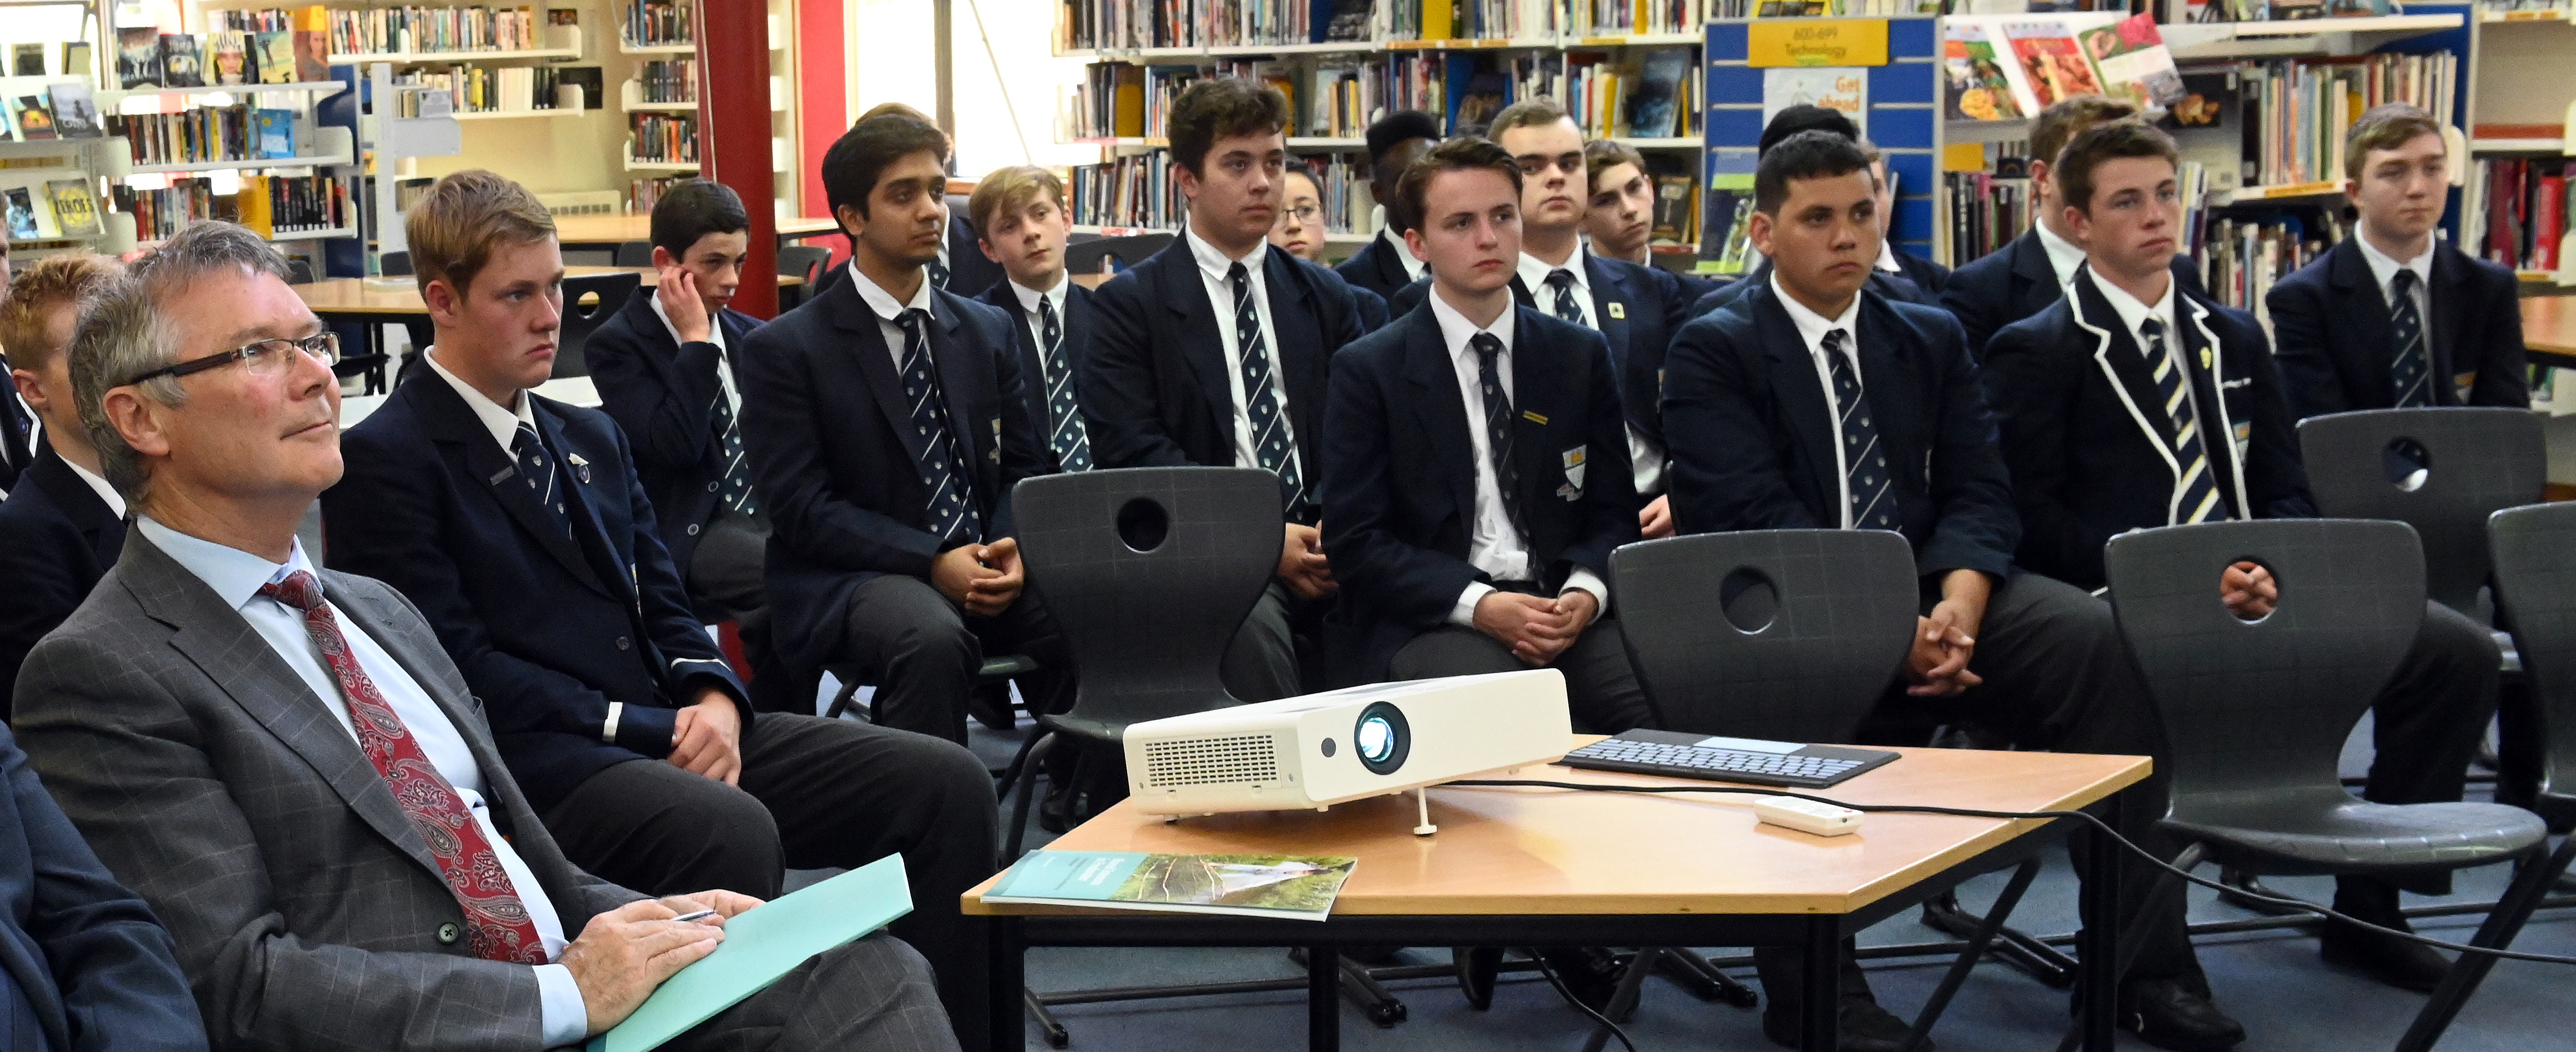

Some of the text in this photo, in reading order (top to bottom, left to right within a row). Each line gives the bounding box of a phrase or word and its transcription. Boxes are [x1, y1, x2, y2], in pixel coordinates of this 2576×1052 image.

[1793, 27, 1838, 40] 600-699
[1785, 43, 1848, 58] Technology
[1836, 75, 1860, 93] Get
[1818, 94, 1860, 112] ahead
